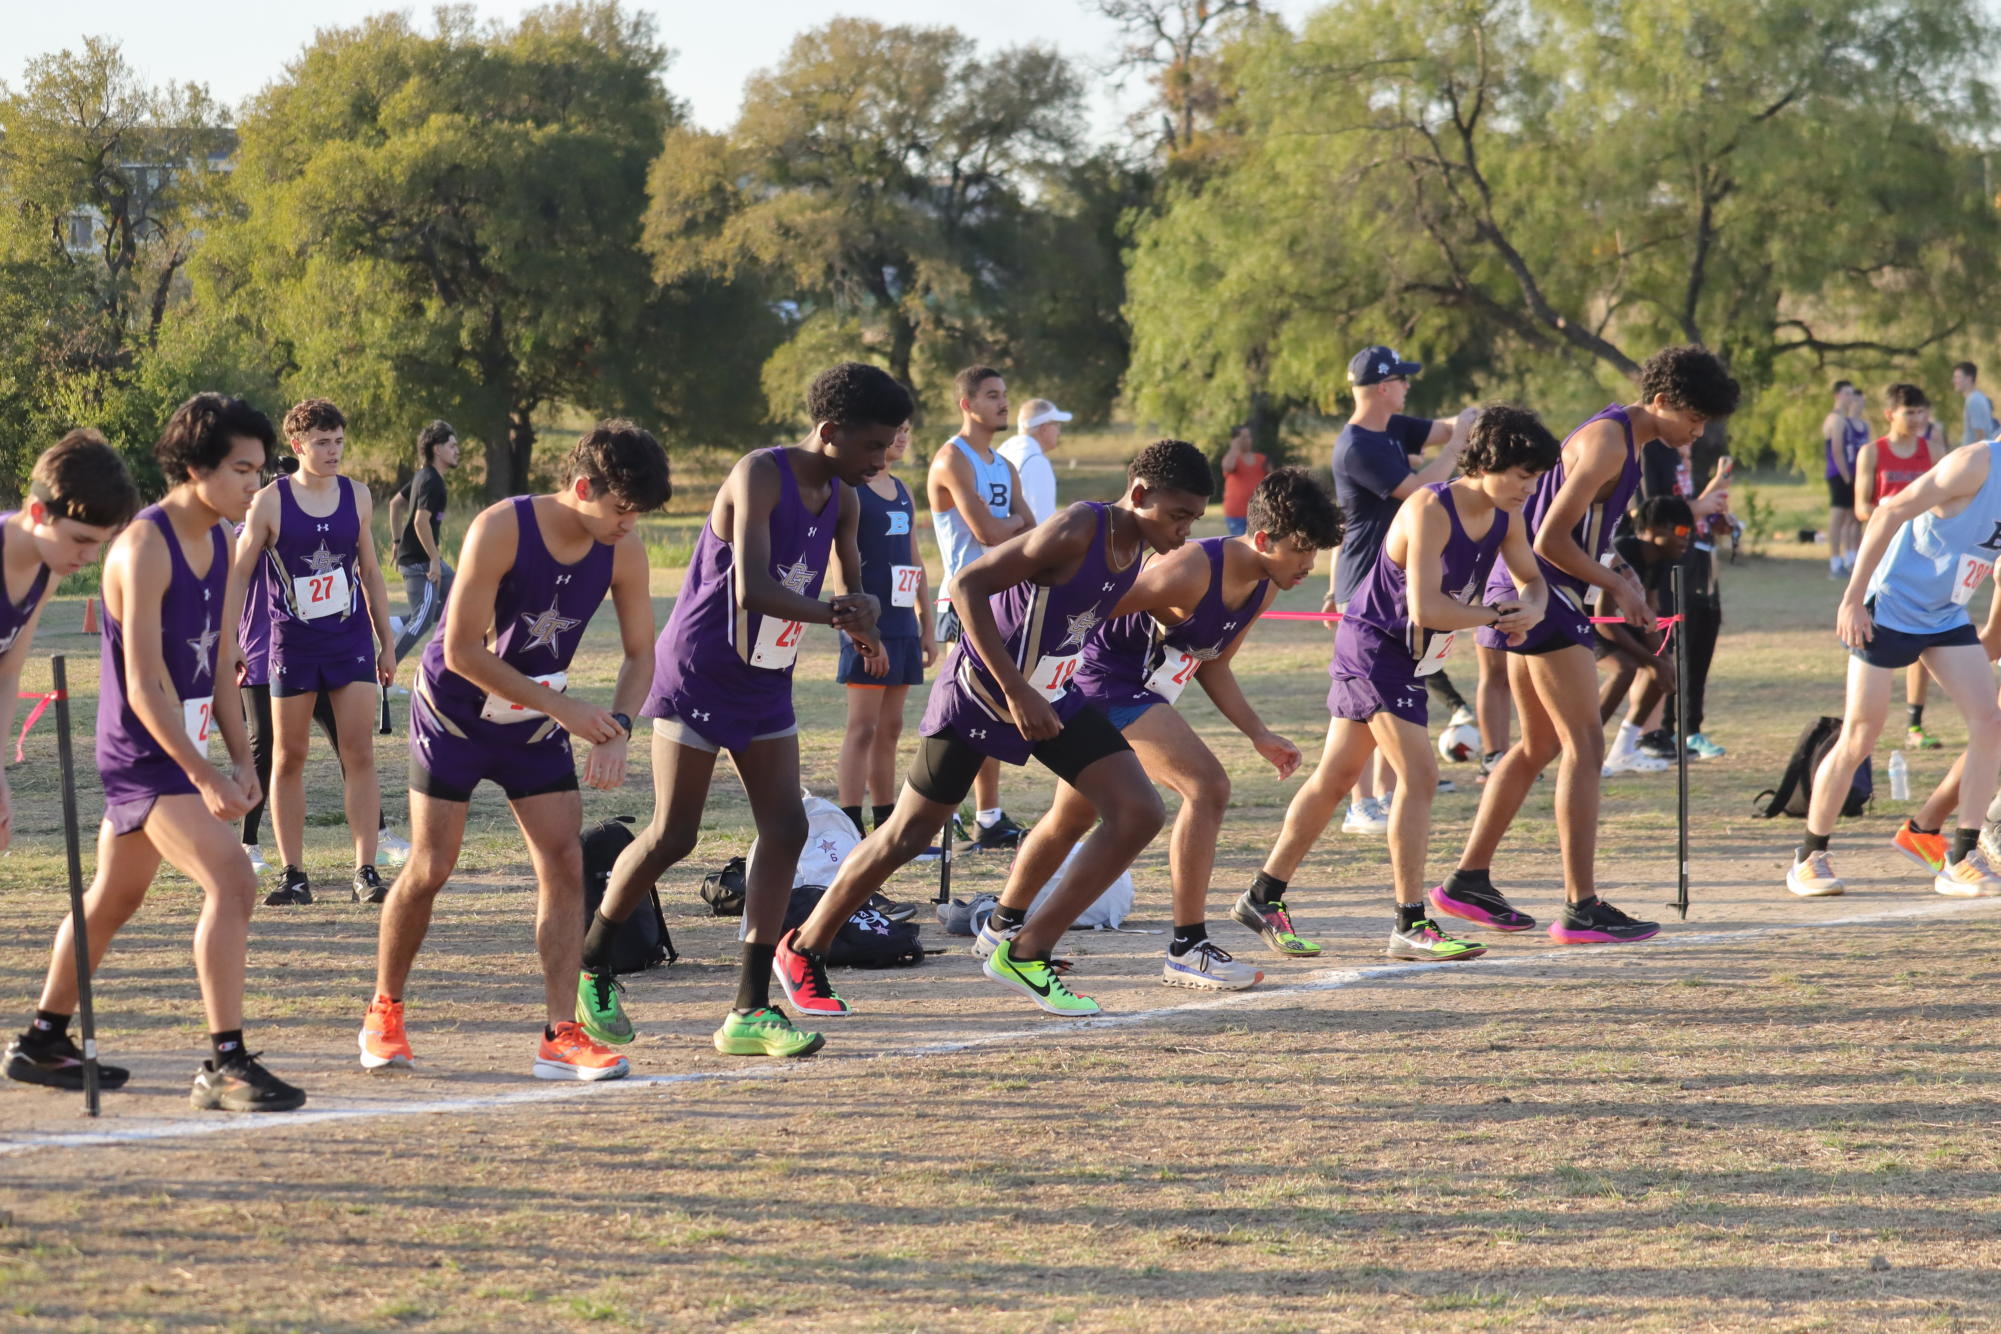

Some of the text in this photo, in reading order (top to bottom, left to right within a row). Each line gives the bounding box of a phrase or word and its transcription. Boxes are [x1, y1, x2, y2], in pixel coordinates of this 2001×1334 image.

[989, 482, 1008, 507] B
[885, 511, 910, 536] B
[309, 576, 334, 603] 27
[198, 704, 213, 741] 2
[830, 853, 838, 863] 6
